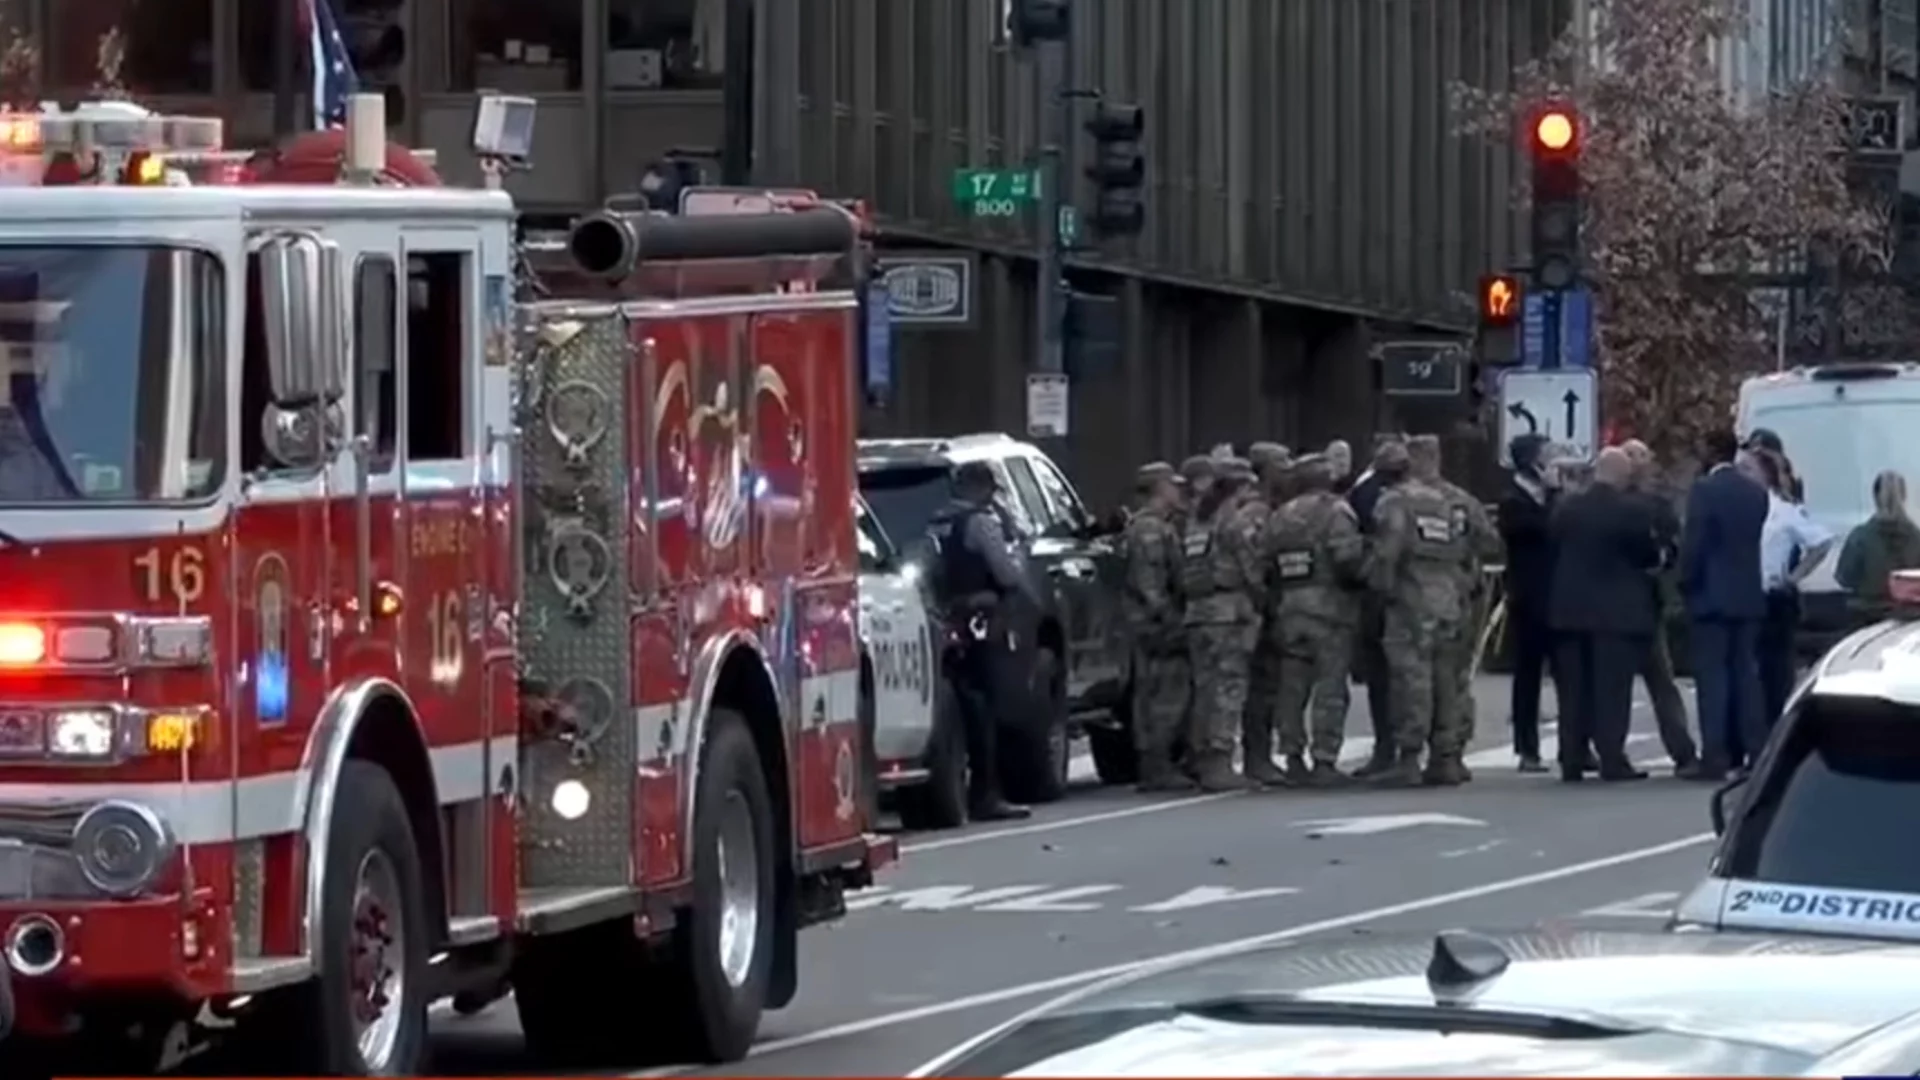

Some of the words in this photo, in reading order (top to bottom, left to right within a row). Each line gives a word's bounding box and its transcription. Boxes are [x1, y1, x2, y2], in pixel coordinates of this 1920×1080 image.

[971, 173, 998, 196] 17
[974, 199, 1015, 216] 800
[134, 546, 205, 602] 16
[428, 587, 464, 686] 16
